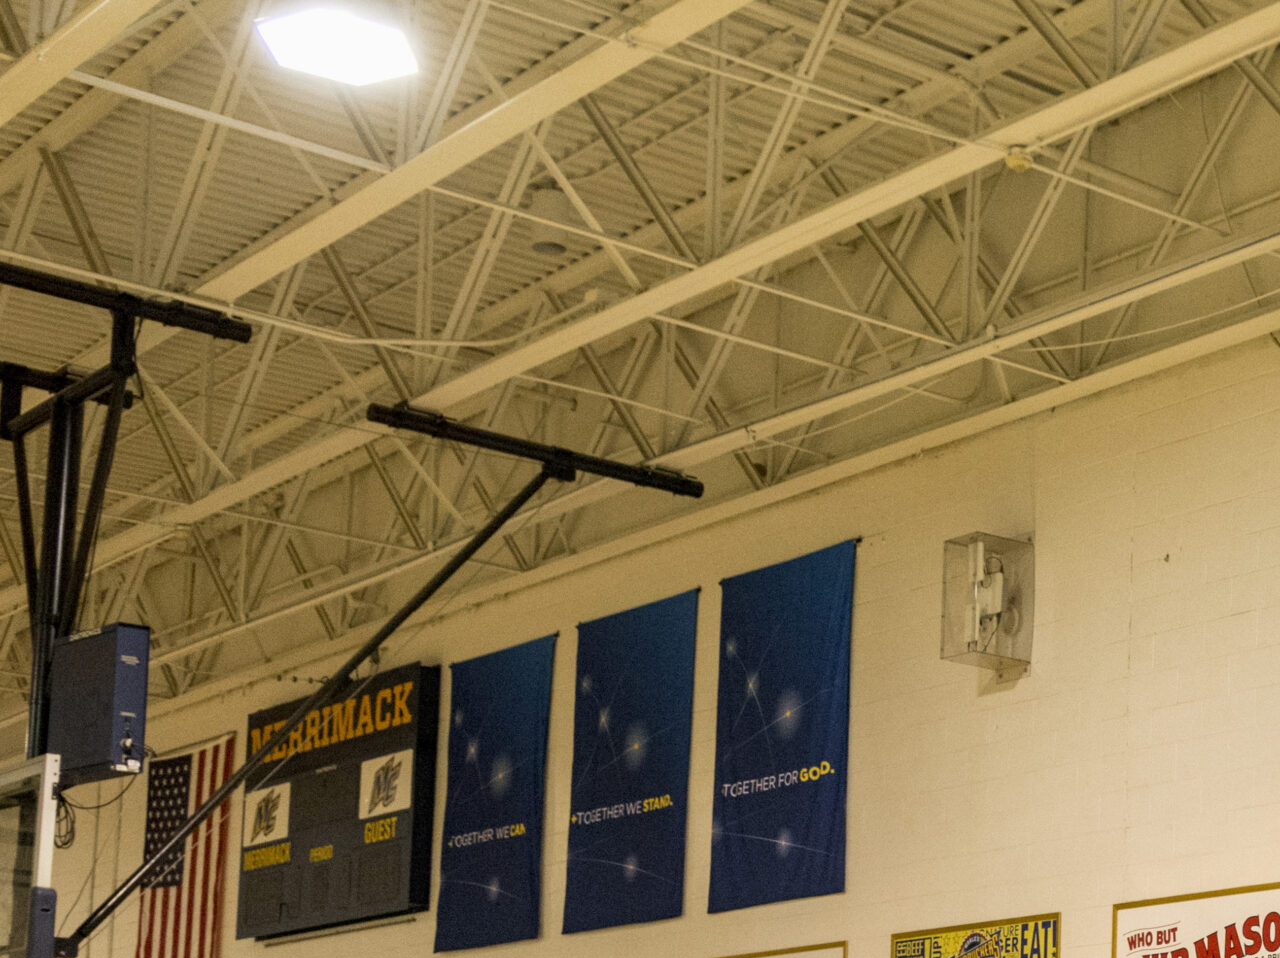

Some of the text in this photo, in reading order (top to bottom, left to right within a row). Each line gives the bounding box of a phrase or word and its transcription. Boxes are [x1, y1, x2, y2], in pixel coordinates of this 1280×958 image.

[778, 770, 798, 788] FOR
[626, 800, 642, 816] WE
[364, 816, 398, 844] GUEST
[496, 825, 510, 840] WE
[1127, 927, 1178, 951] WHO BUT
